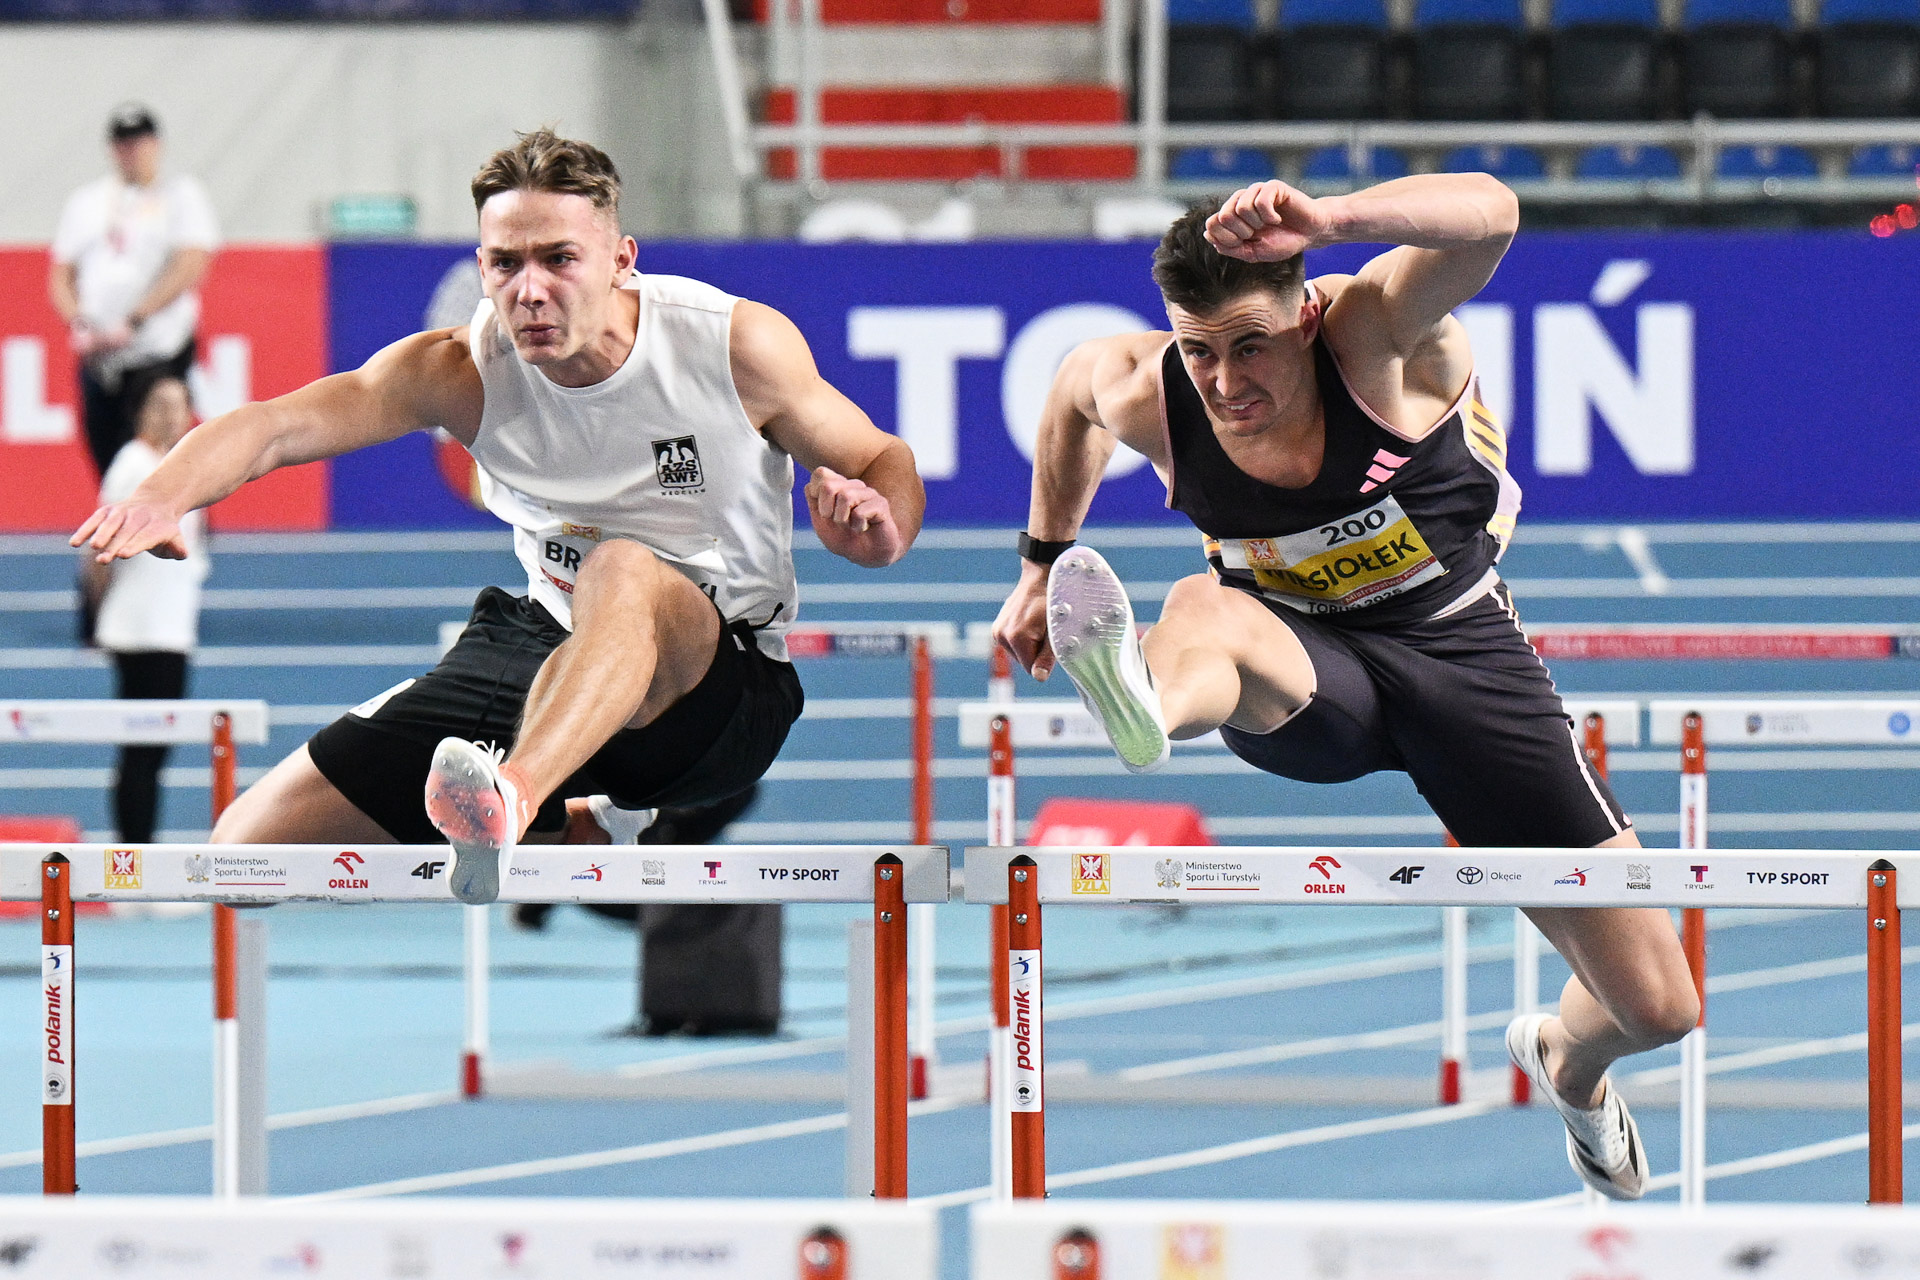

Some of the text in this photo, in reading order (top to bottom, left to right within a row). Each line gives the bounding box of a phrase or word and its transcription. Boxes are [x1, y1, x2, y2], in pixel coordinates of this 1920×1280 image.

[661, 459, 697, 474] AZS
[662, 471, 699, 483] AWF
[1320, 509, 1387, 547] 200
[1403, 559, 1431, 579] Polski
[214, 857, 269, 866] Ministerstwo
[1185, 861, 1242, 870] Ministerstwo
[214, 868, 243, 877] Sportu
[250, 868, 287, 877] Turystyki
[411, 861, 446, 880] 4F
[509, 867, 540, 877] Okęcie
[759, 868, 840, 881] TVP SPORT
[1389, 866, 1425, 884] 4F
[1185, 873, 1215, 882] Sportu
[1222, 873, 1261, 882] Turystyki
[1490, 872, 1522, 882] Okęcie
[1553, 878, 1579, 886] polanik
[1747, 872, 1829, 885] TVP SPORT
[329, 879, 369, 889] ORLEN
[1304, 884, 1345, 894] ORLEN
[44, 983, 65, 1065] polanik
[1014, 988, 1035, 1071] polanik
